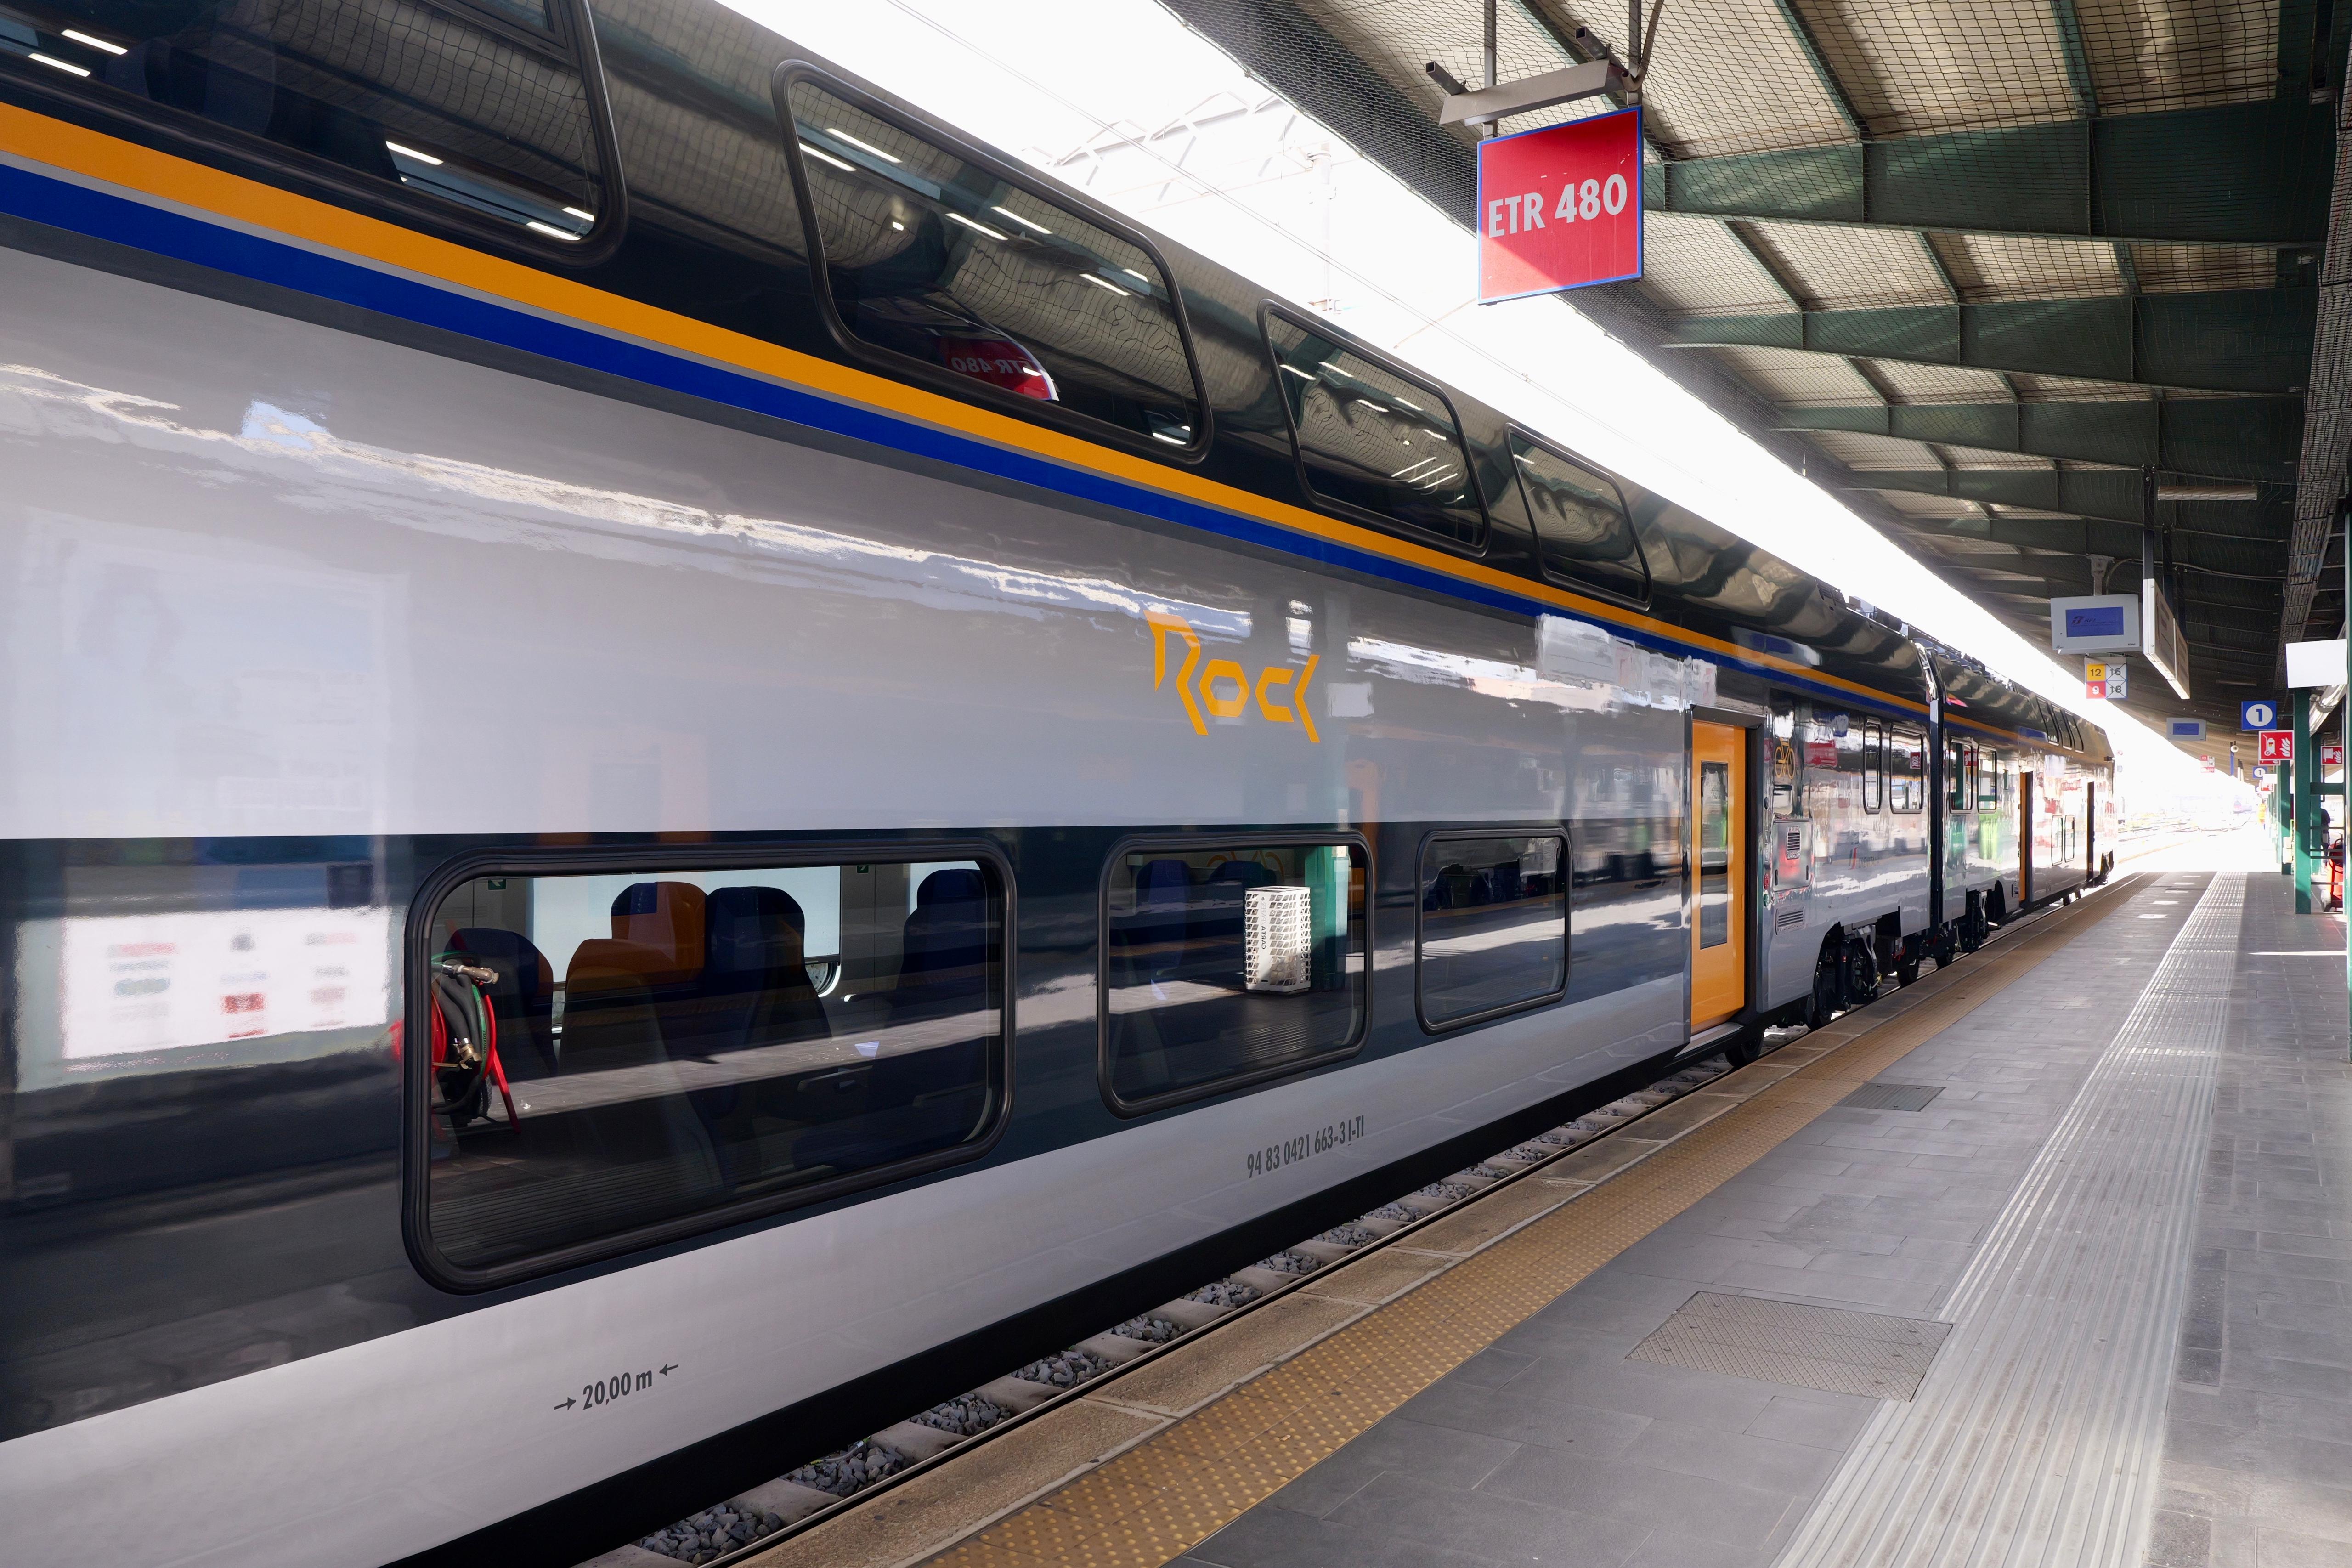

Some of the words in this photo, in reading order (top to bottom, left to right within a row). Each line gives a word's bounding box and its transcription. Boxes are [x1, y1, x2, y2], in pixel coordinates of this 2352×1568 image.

[1489, 192, 1545, 238] ETR
[1555, 174, 1627, 223] 480
[2110, 668, 2121, 676] 16
[2092, 685, 2099, 695] 9
[2256, 708, 2262, 722] 1
[1247, 1151, 1261, 1178] 94
[1266, 1144, 1280, 1172] 83
[1284, 1134, 1310, 1165] 0421
[583, 1372, 631, 1410] 20,00
[636, 1370, 652, 1391] m
